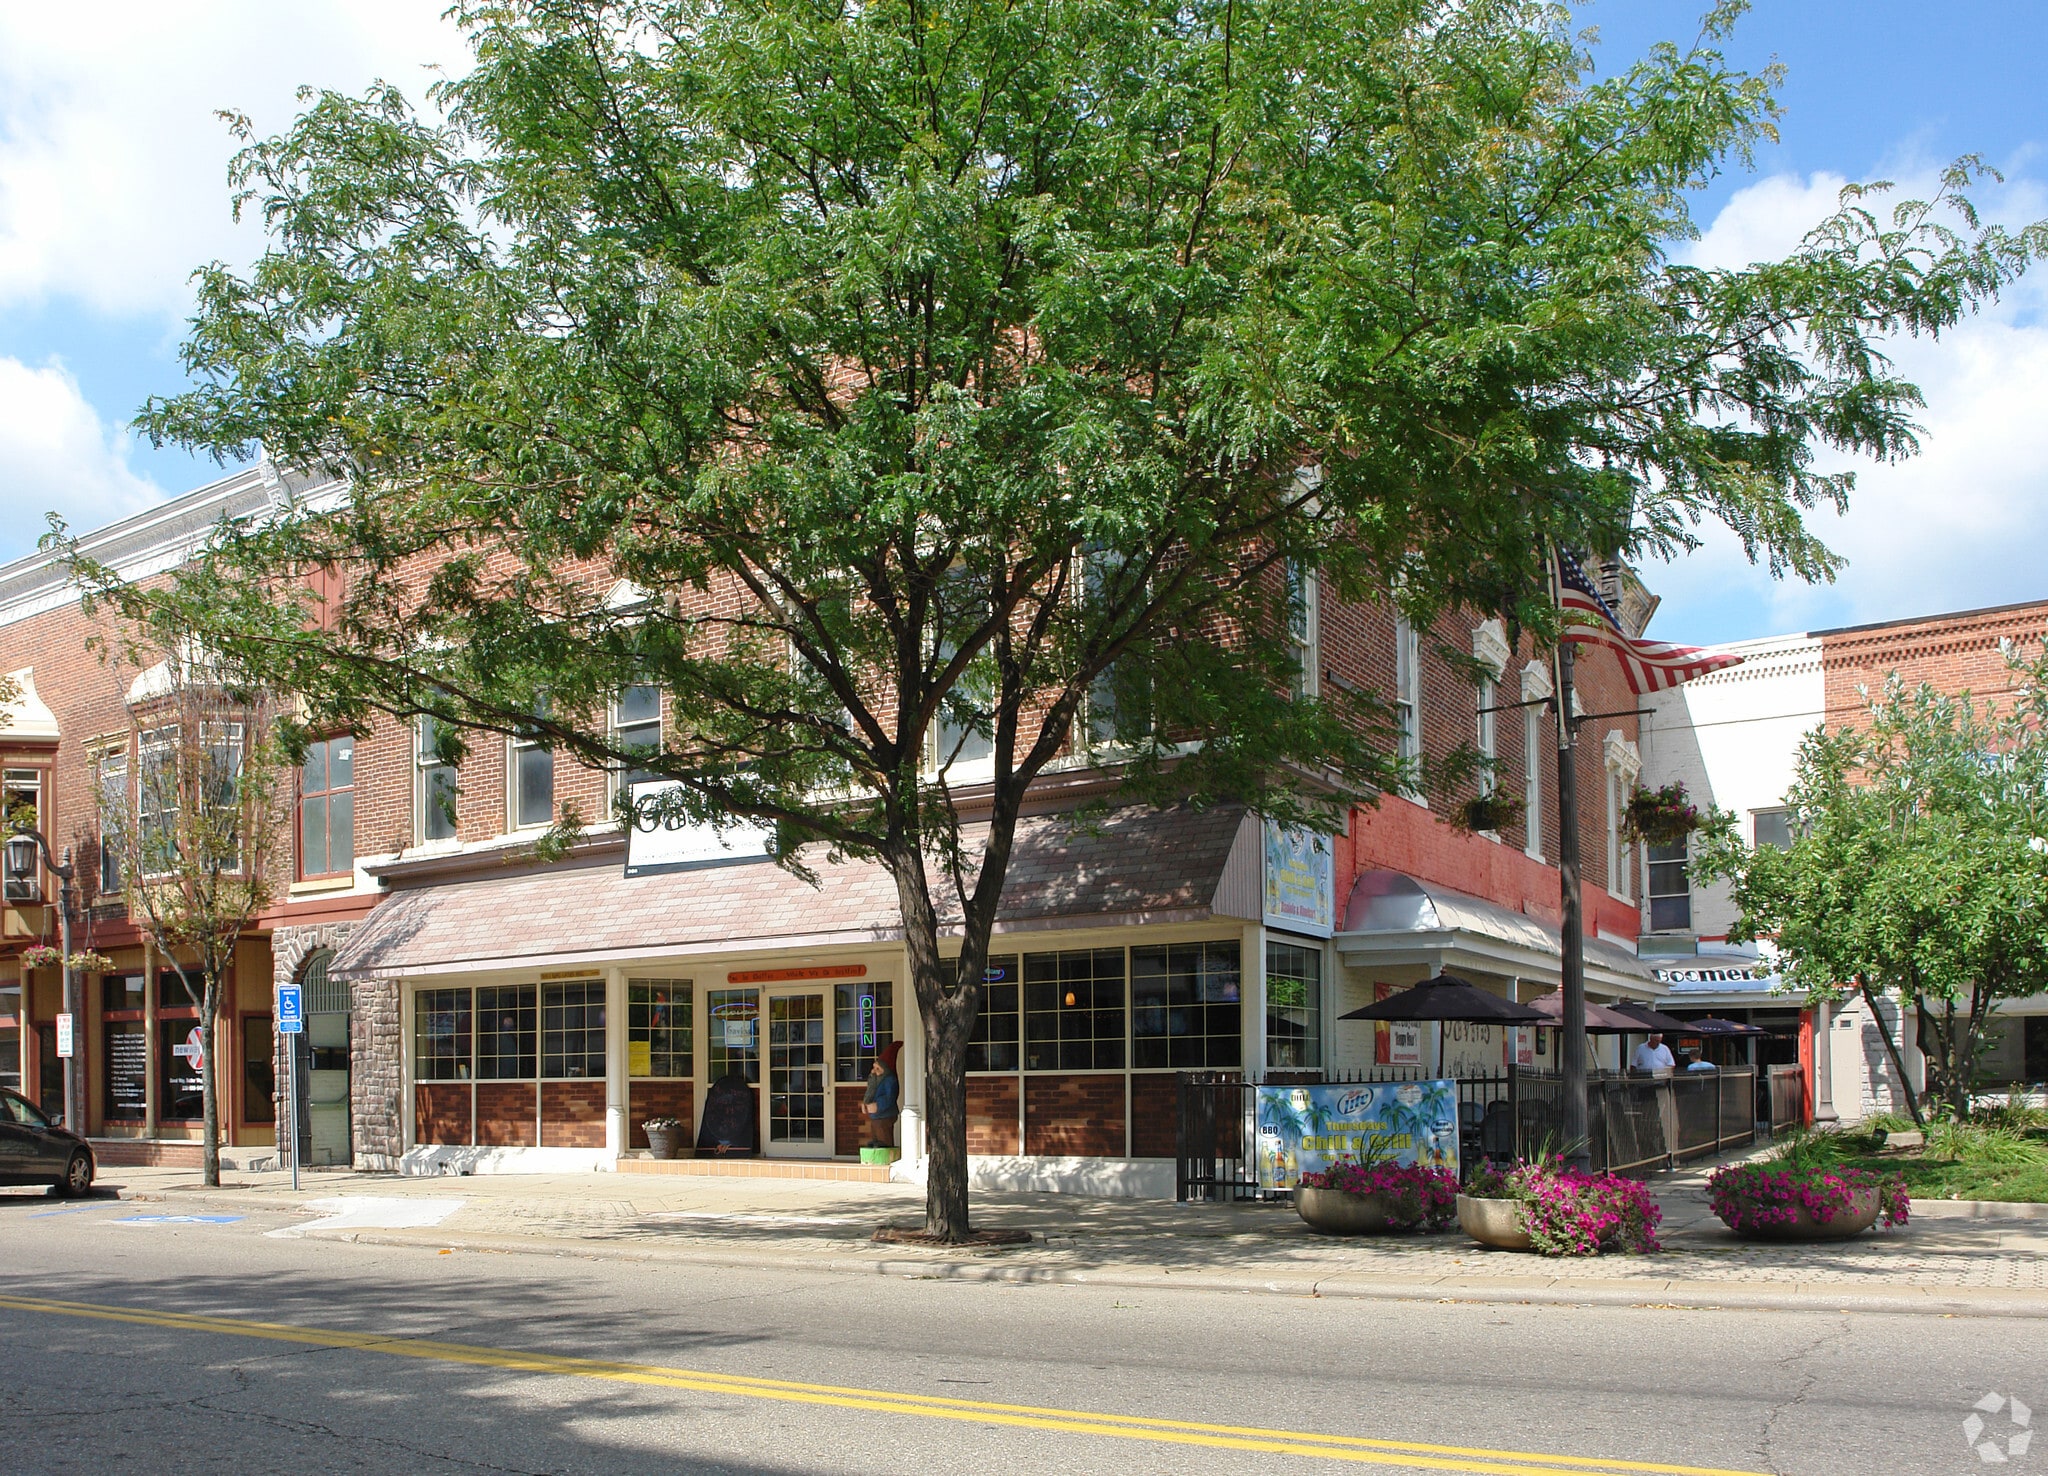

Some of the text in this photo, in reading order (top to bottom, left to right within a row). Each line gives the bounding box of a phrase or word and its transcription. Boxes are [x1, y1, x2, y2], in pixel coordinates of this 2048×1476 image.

[862, 997, 873, 1046] OPEN
[1343, 1093, 1369, 1114] Lite
[1262, 1125, 1278, 1135] BBQ
[1326, 1121, 1388, 1132] Thursdays
[1302, 1133, 1412, 1151] Chill & Grill
